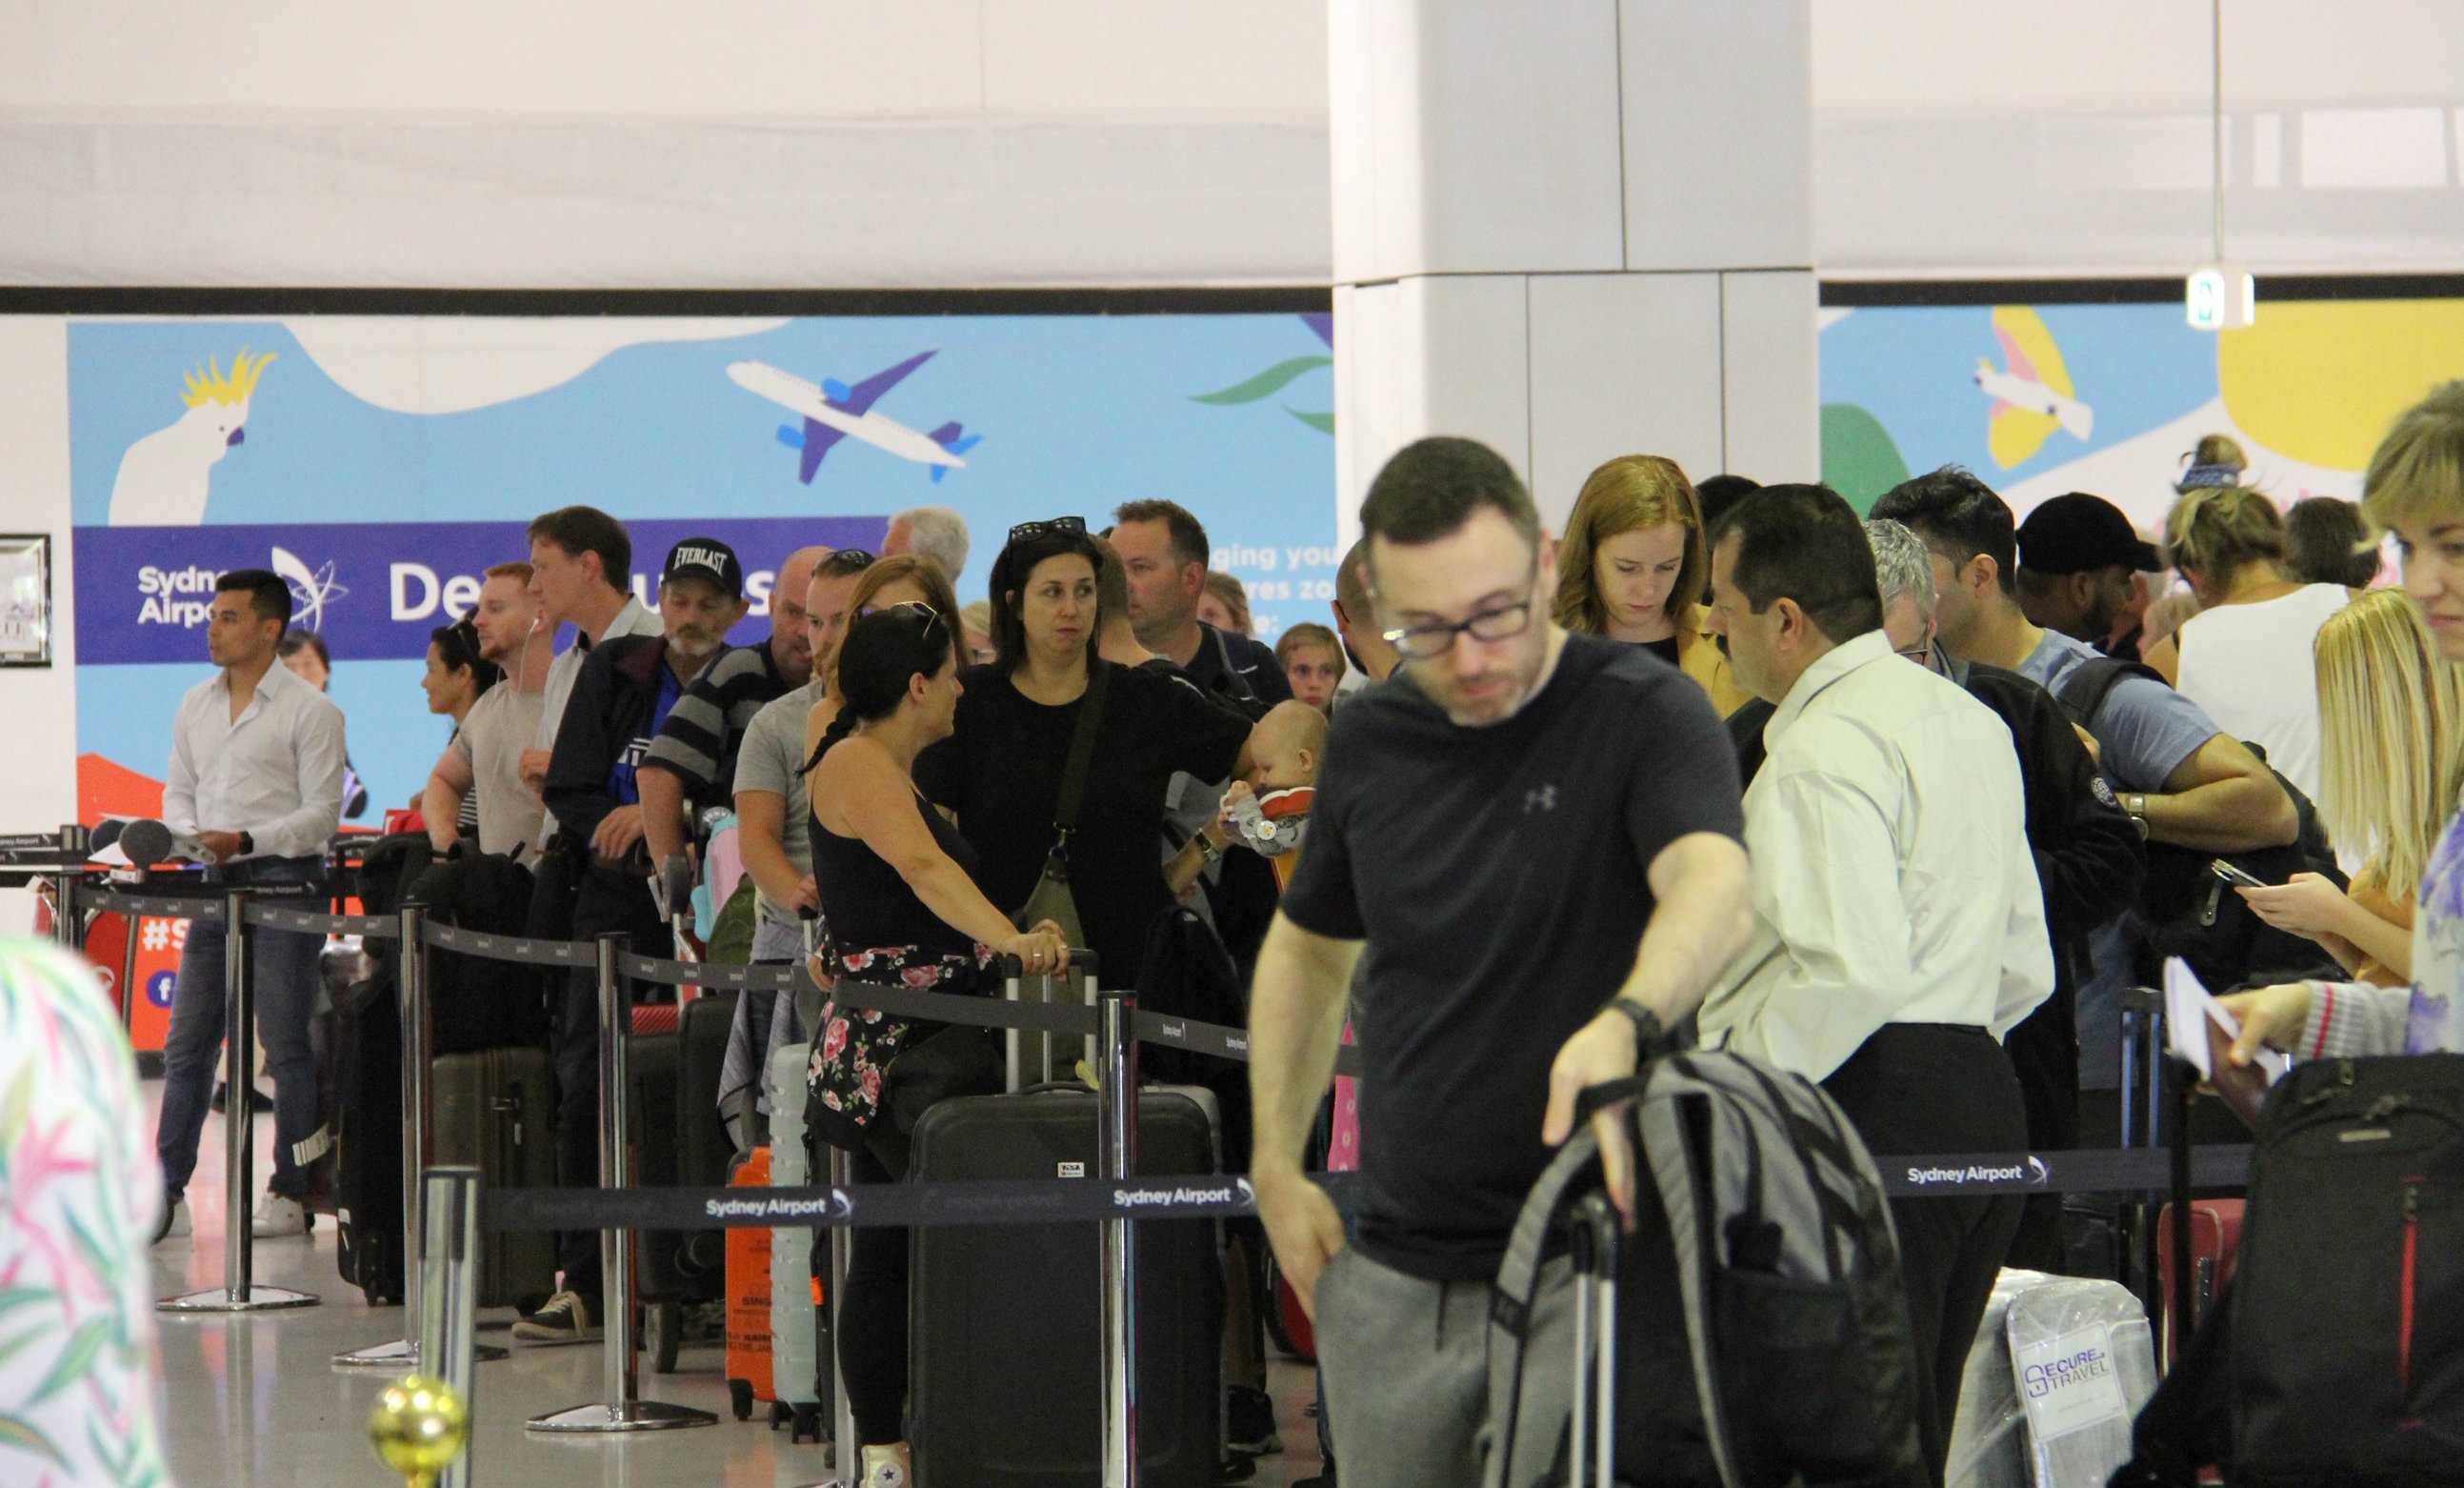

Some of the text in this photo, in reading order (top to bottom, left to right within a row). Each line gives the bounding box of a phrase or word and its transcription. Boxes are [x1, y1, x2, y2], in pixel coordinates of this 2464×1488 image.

[673, 547, 728, 577] EVERLAST
[1212, 546, 1275, 570] ging
[138, 565, 229, 597] Sydn
[1246, 580, 1332, 600] res zo
[137, 597, 214, 629] Airp
[143, 921, 189, 951] #S
[1908, 1165, 2023, 1184] Sydney Airport
[706, 1197, 826, 1217] Sydney Airport
[1113, 1188, 1231, 1207] Sydney Airport
[2050, 1360, 2109, 1390] TRAVEL
